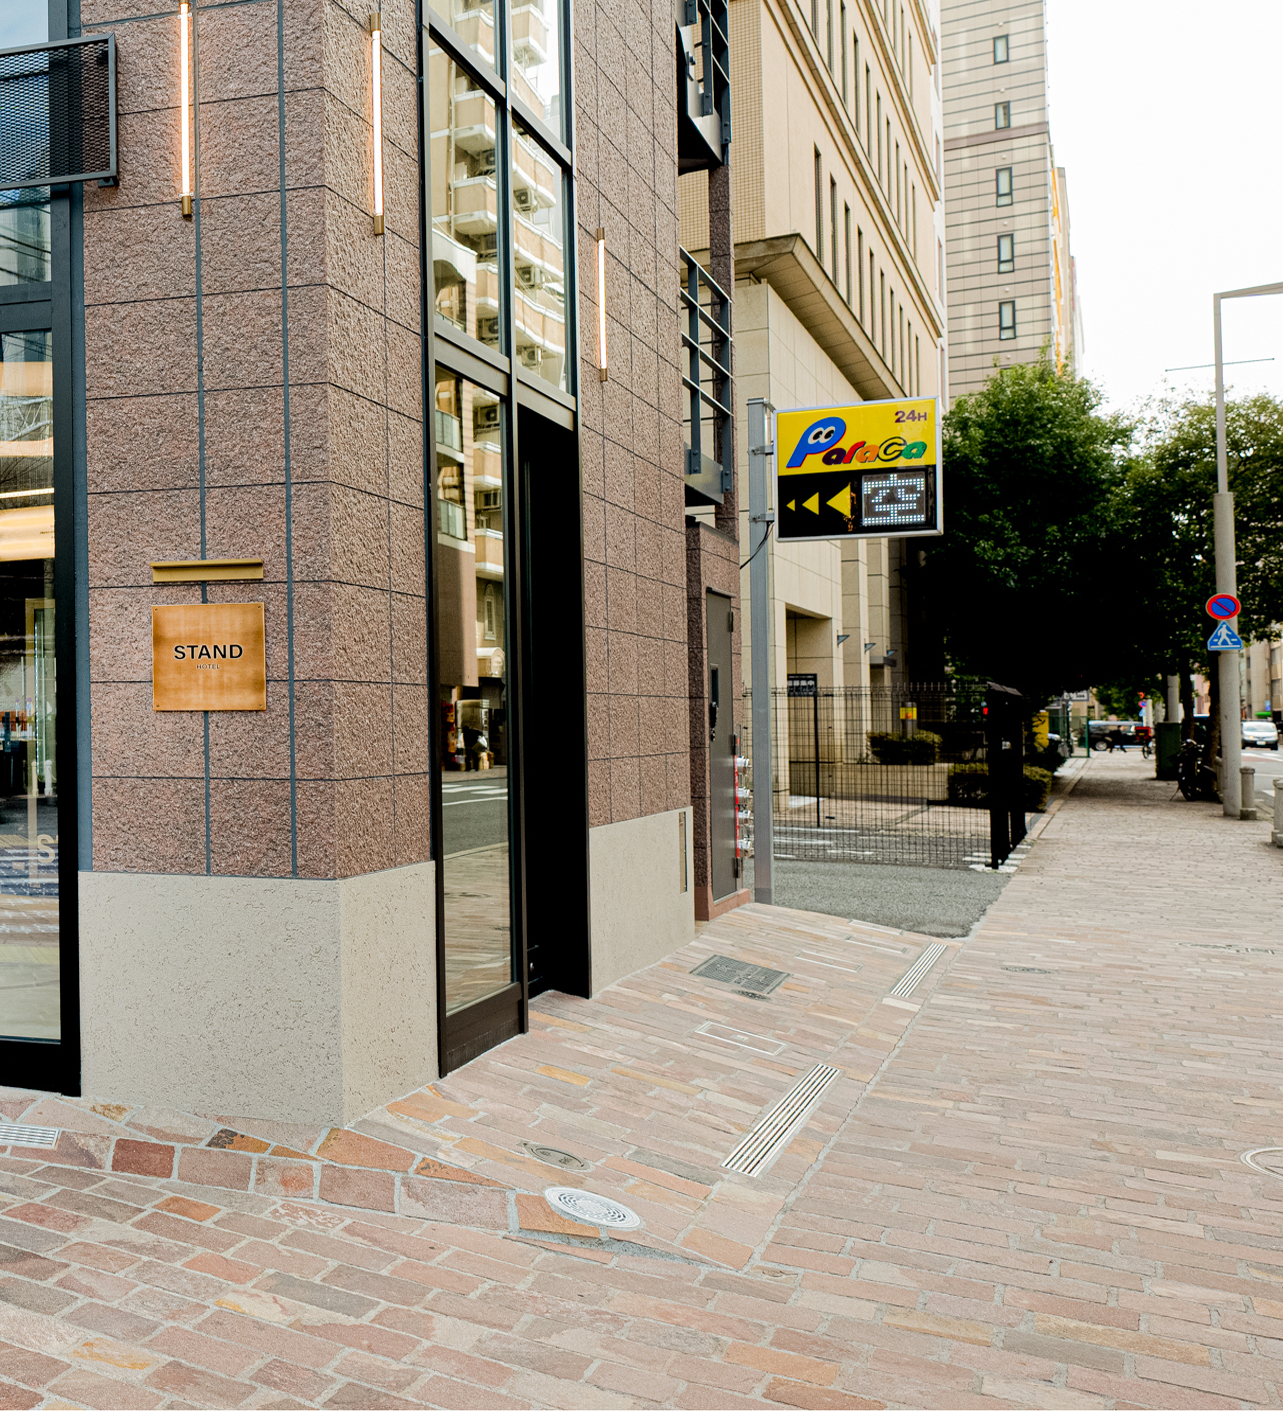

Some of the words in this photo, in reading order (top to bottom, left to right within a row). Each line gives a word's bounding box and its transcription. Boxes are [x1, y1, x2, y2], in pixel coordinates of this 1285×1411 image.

[894, 410, 927, 423] 24H
[864, 473, 924, 524] 空
[174, 644, 243, 660] STAND
